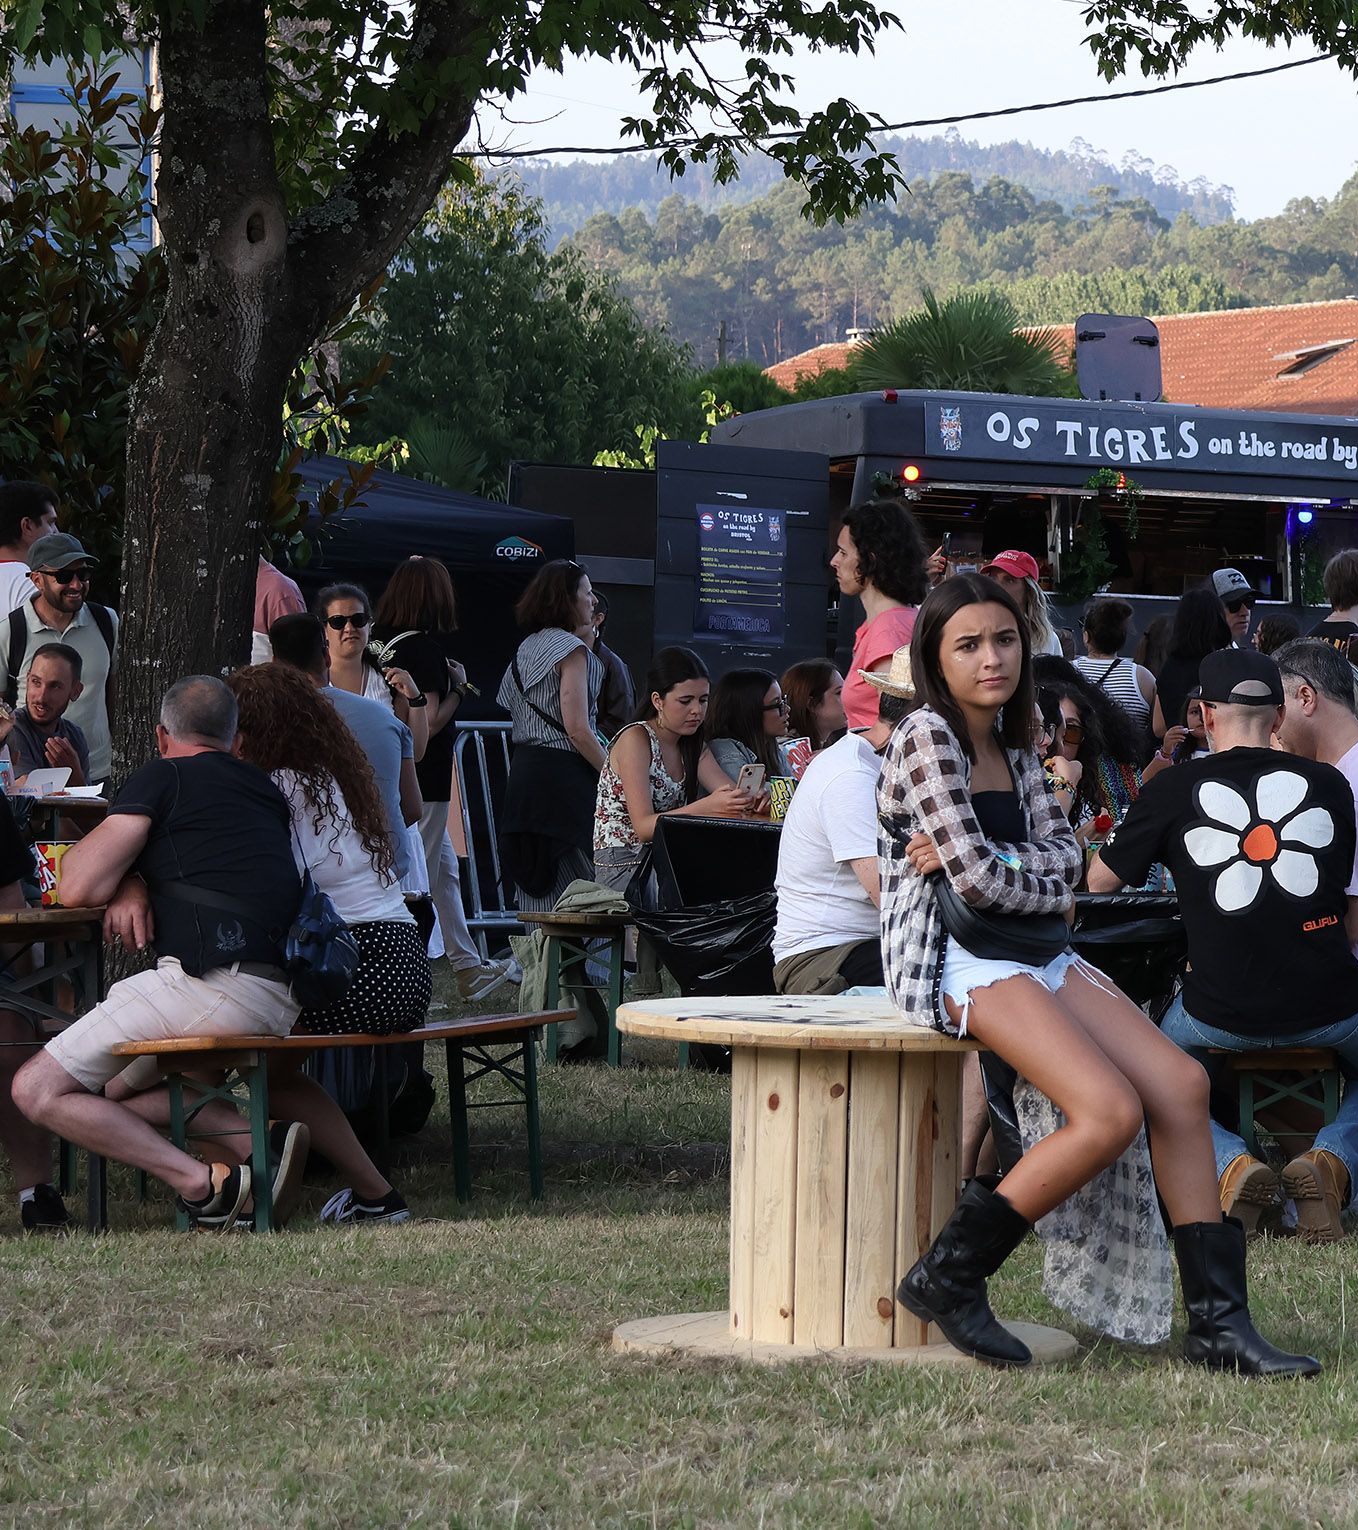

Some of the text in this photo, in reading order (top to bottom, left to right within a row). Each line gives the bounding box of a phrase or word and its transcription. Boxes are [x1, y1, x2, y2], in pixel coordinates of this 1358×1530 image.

[986, 411, 1358, 470] OS TIGRES on the road by
[718, 511, 763, 523] OS TIGRES
[496, 546, 538, 557] COBIZI
[1147, 864, 1159, 886] 190
[1302, 915, 1338, 931] GURU
